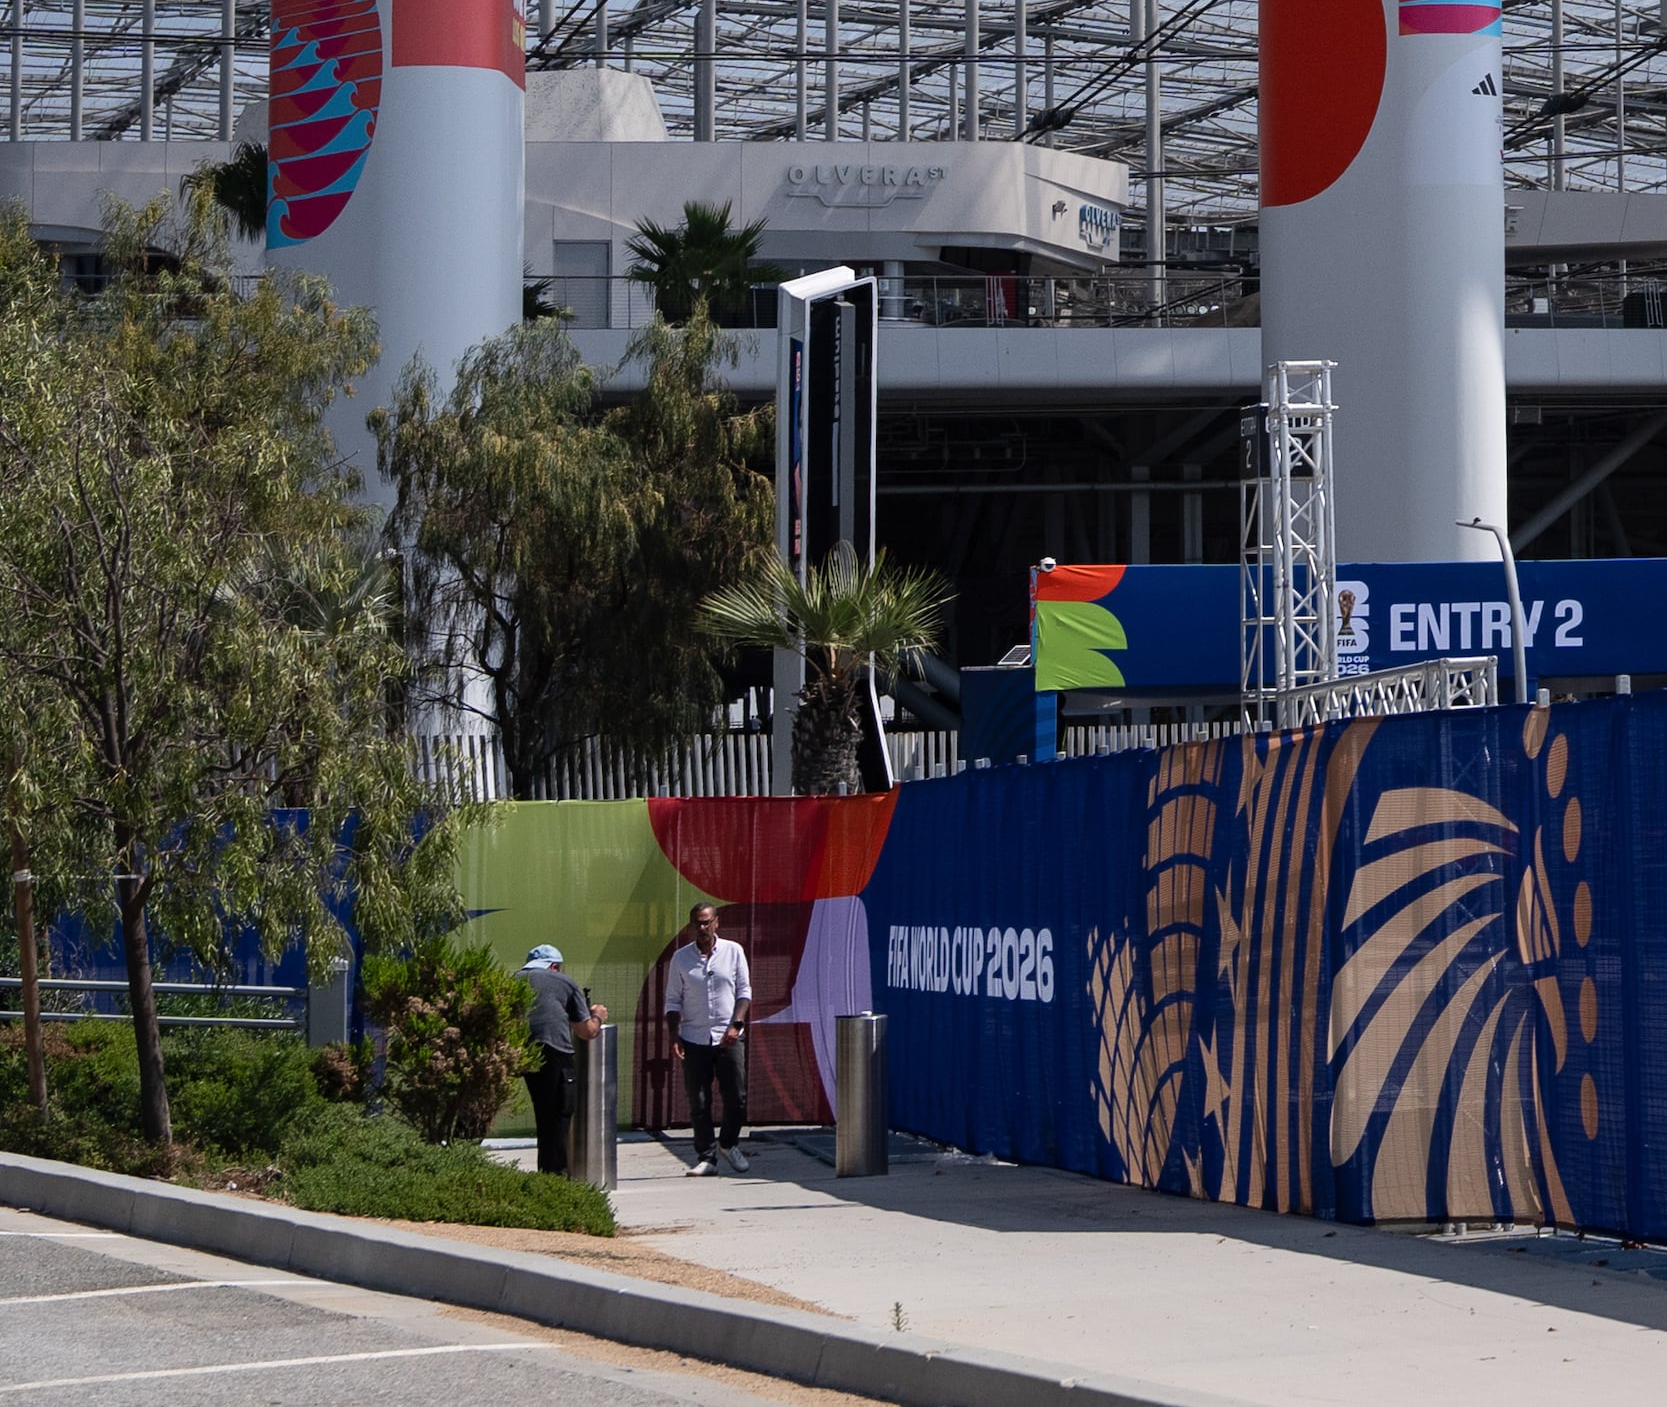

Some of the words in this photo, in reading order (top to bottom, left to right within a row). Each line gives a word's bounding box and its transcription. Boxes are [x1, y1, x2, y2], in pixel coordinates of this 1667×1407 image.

[787, 165, 923, 186] OLVERA
[1554, 599, 1583, 647] 2
[1337, 638, 1357, 647] FIFA
[1337, 664, 1369, 675] 026
[887, 925, 909, 989] FIFA
[910, 926, 950, 992] WORLD
[951, 926, 984, 995] CUP
[986, 927, 1055, 1003] 2026
